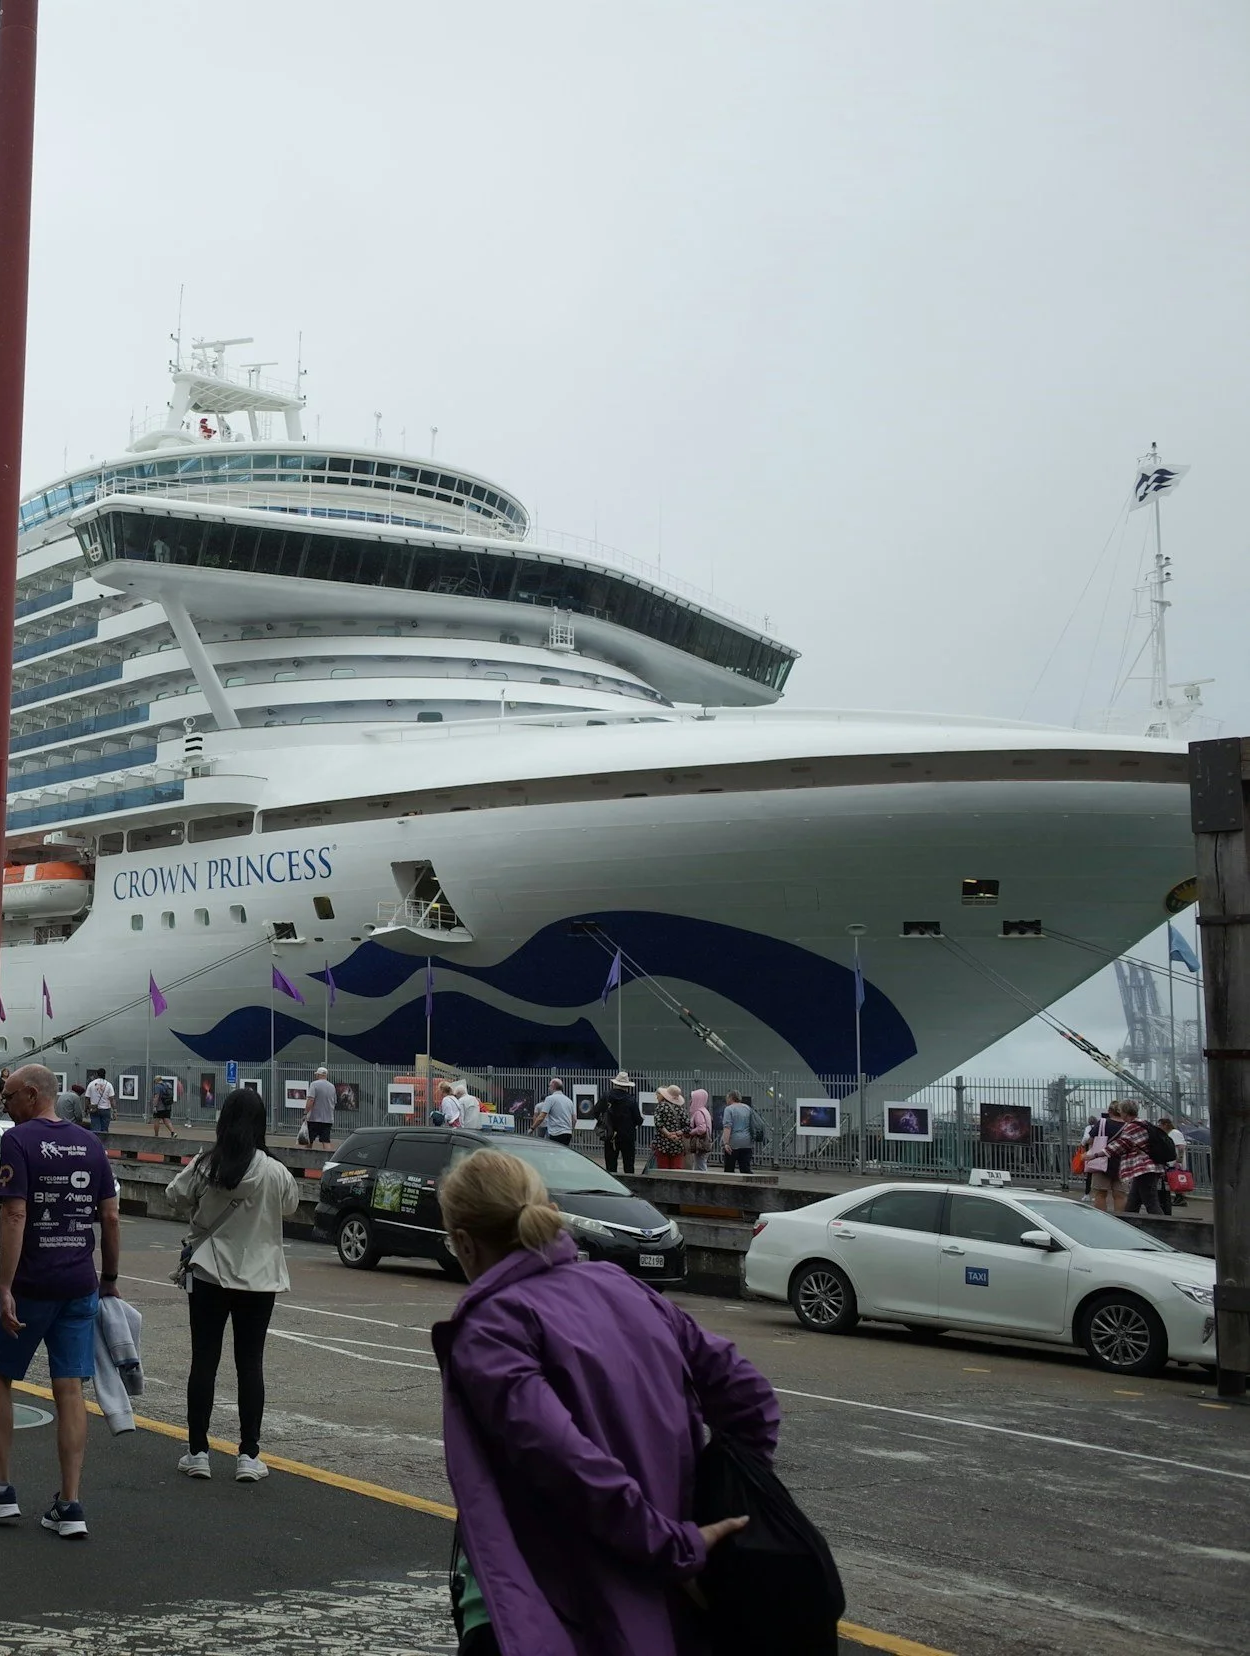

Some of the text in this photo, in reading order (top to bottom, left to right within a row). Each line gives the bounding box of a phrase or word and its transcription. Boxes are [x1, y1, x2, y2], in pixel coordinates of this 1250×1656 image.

[113, 847, 332, 900] CROWN PRINCESS
[487, 1115, 507, 1125] TAXI
[987, 1171, 1002, 1179] TAXI
[967, 1271, 987, 1282] TAXI
